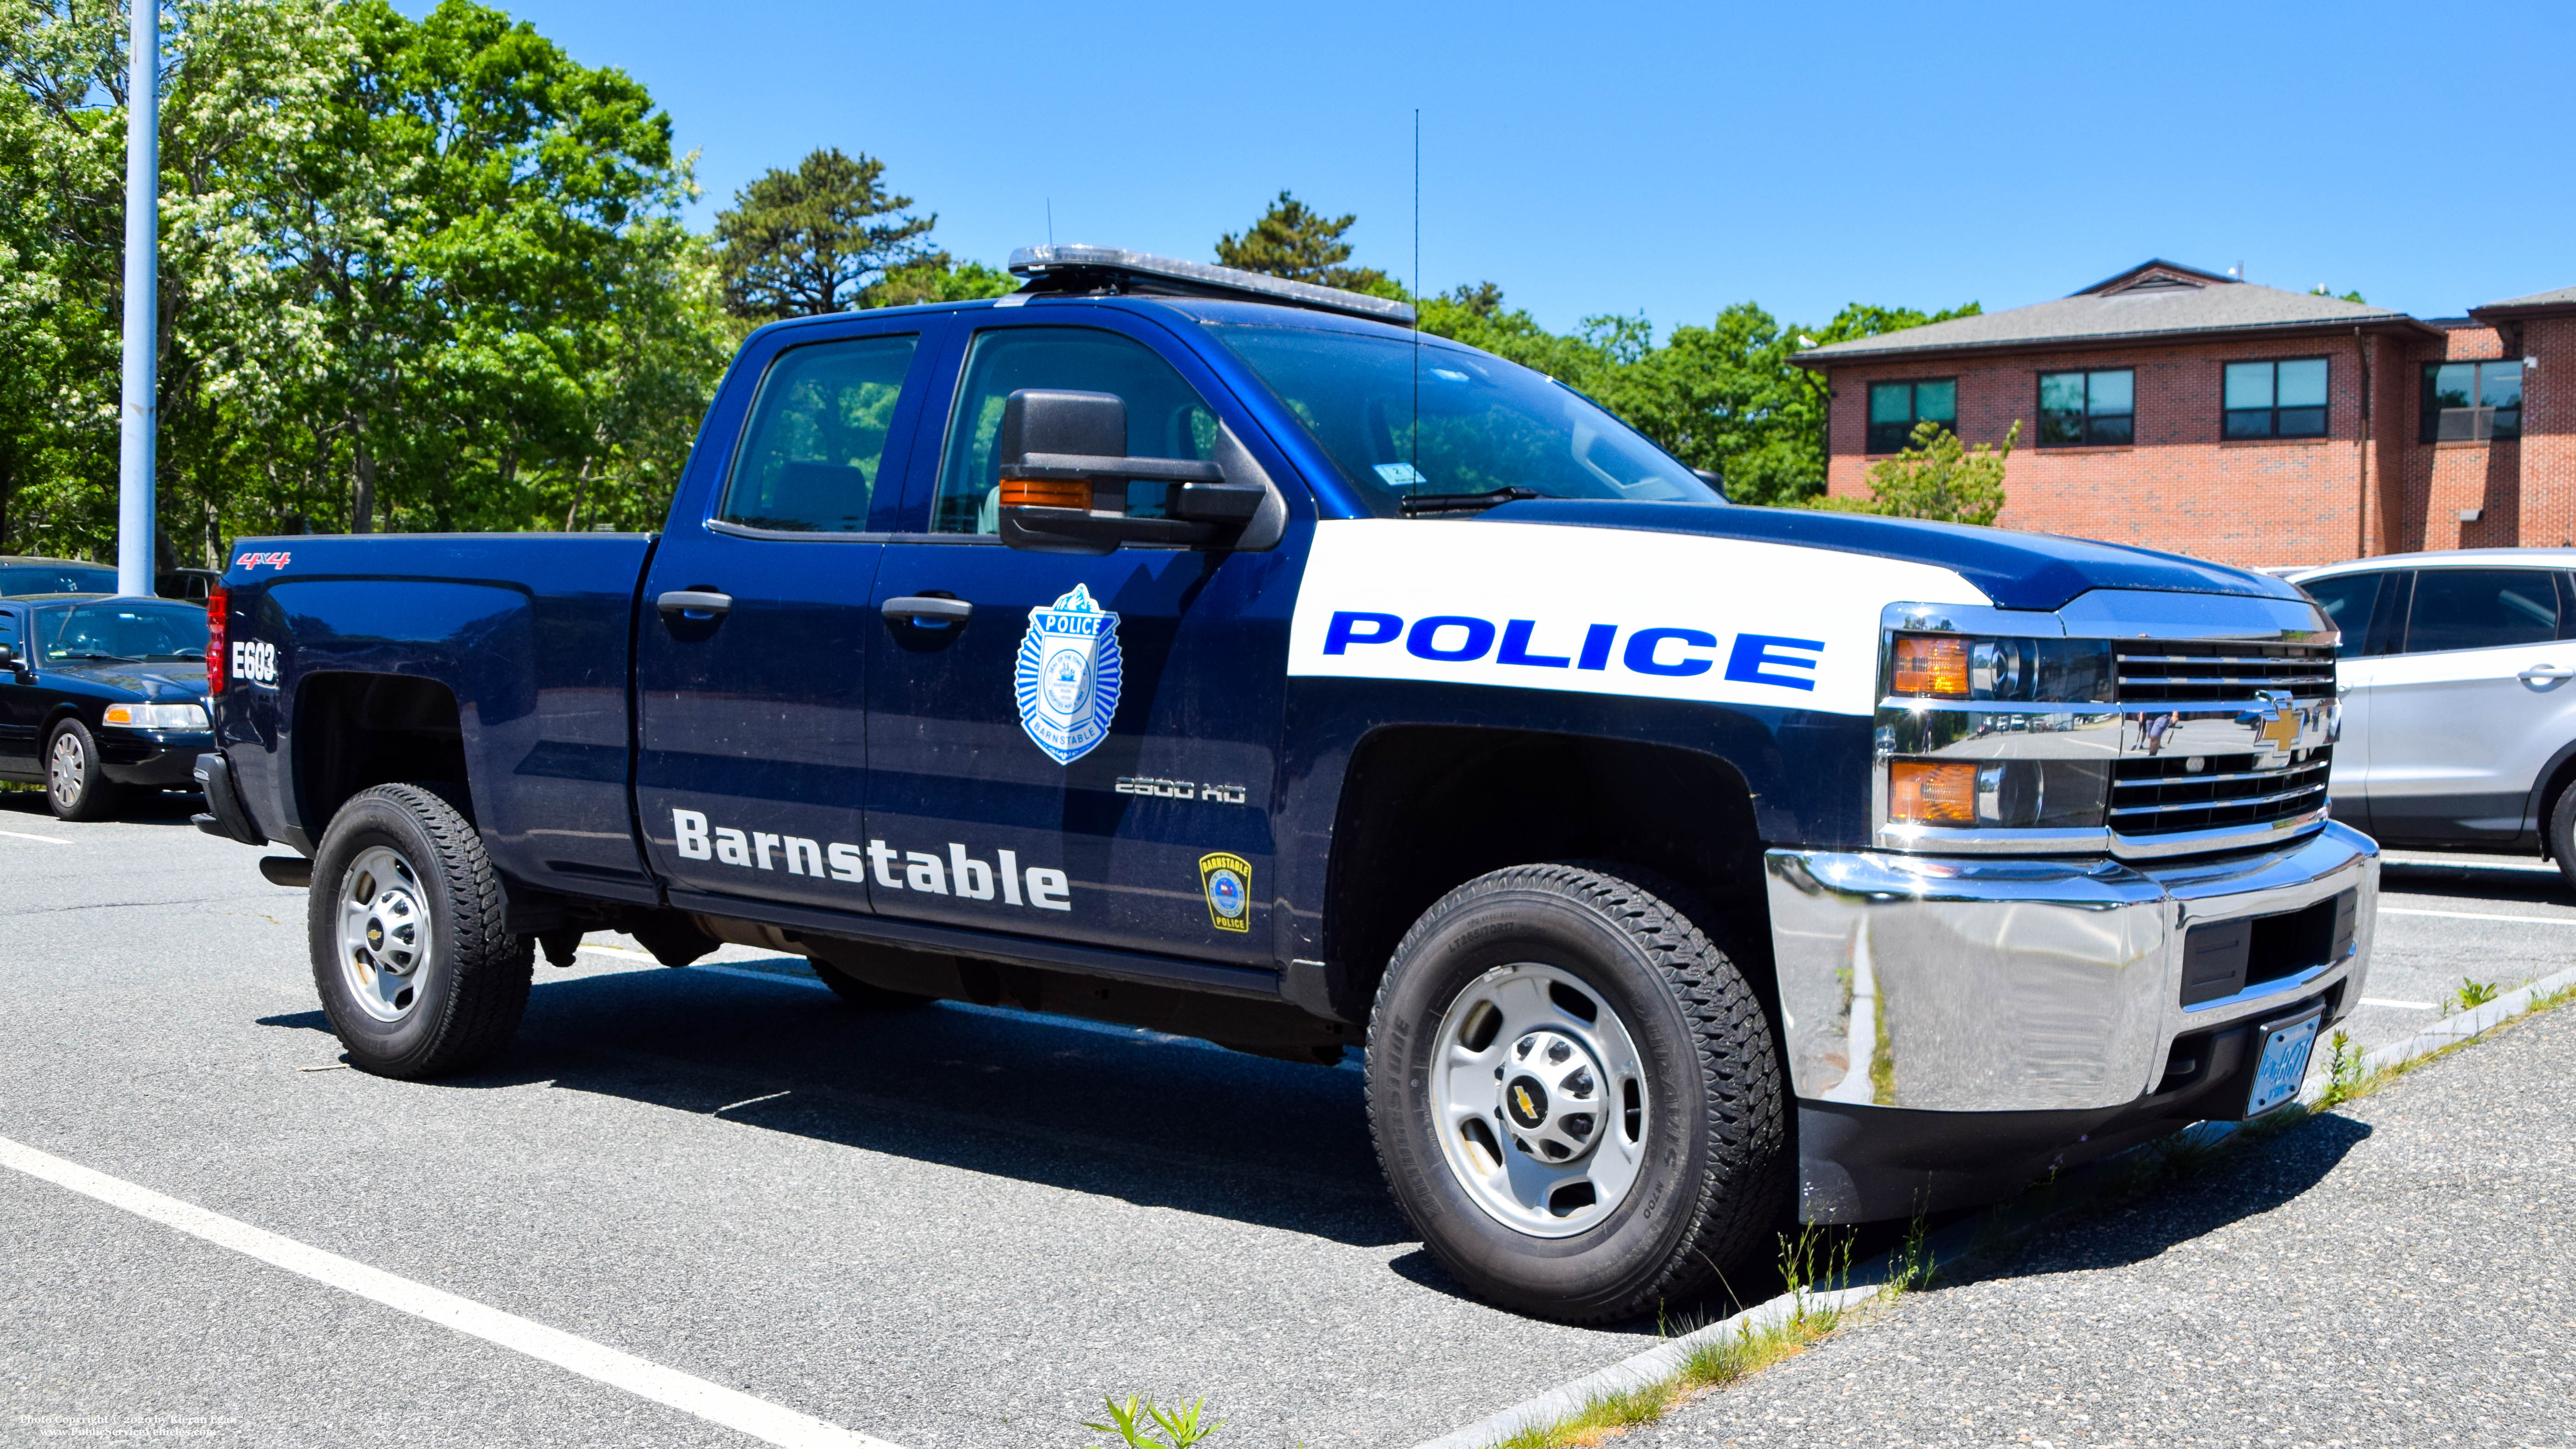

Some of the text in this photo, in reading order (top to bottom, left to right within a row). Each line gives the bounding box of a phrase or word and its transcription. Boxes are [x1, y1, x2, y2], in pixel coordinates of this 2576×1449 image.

[1046, 616, 1101, 635] POLICE
[233, 642, 275, 681] E603
[1323, 611, 1825, 691] POLICE
[1034, 722, 1096, 745] BARNSTABLE
[1115, 777, 1246, 804] 2500 HD
[672, 809, 1071, 911] Barnstable
[1202, 857, 1248, 877] BARNSTABLE
[1216, 917, 1244, 929] POLICE
[1644, 1180, 1664, 1219] M700
